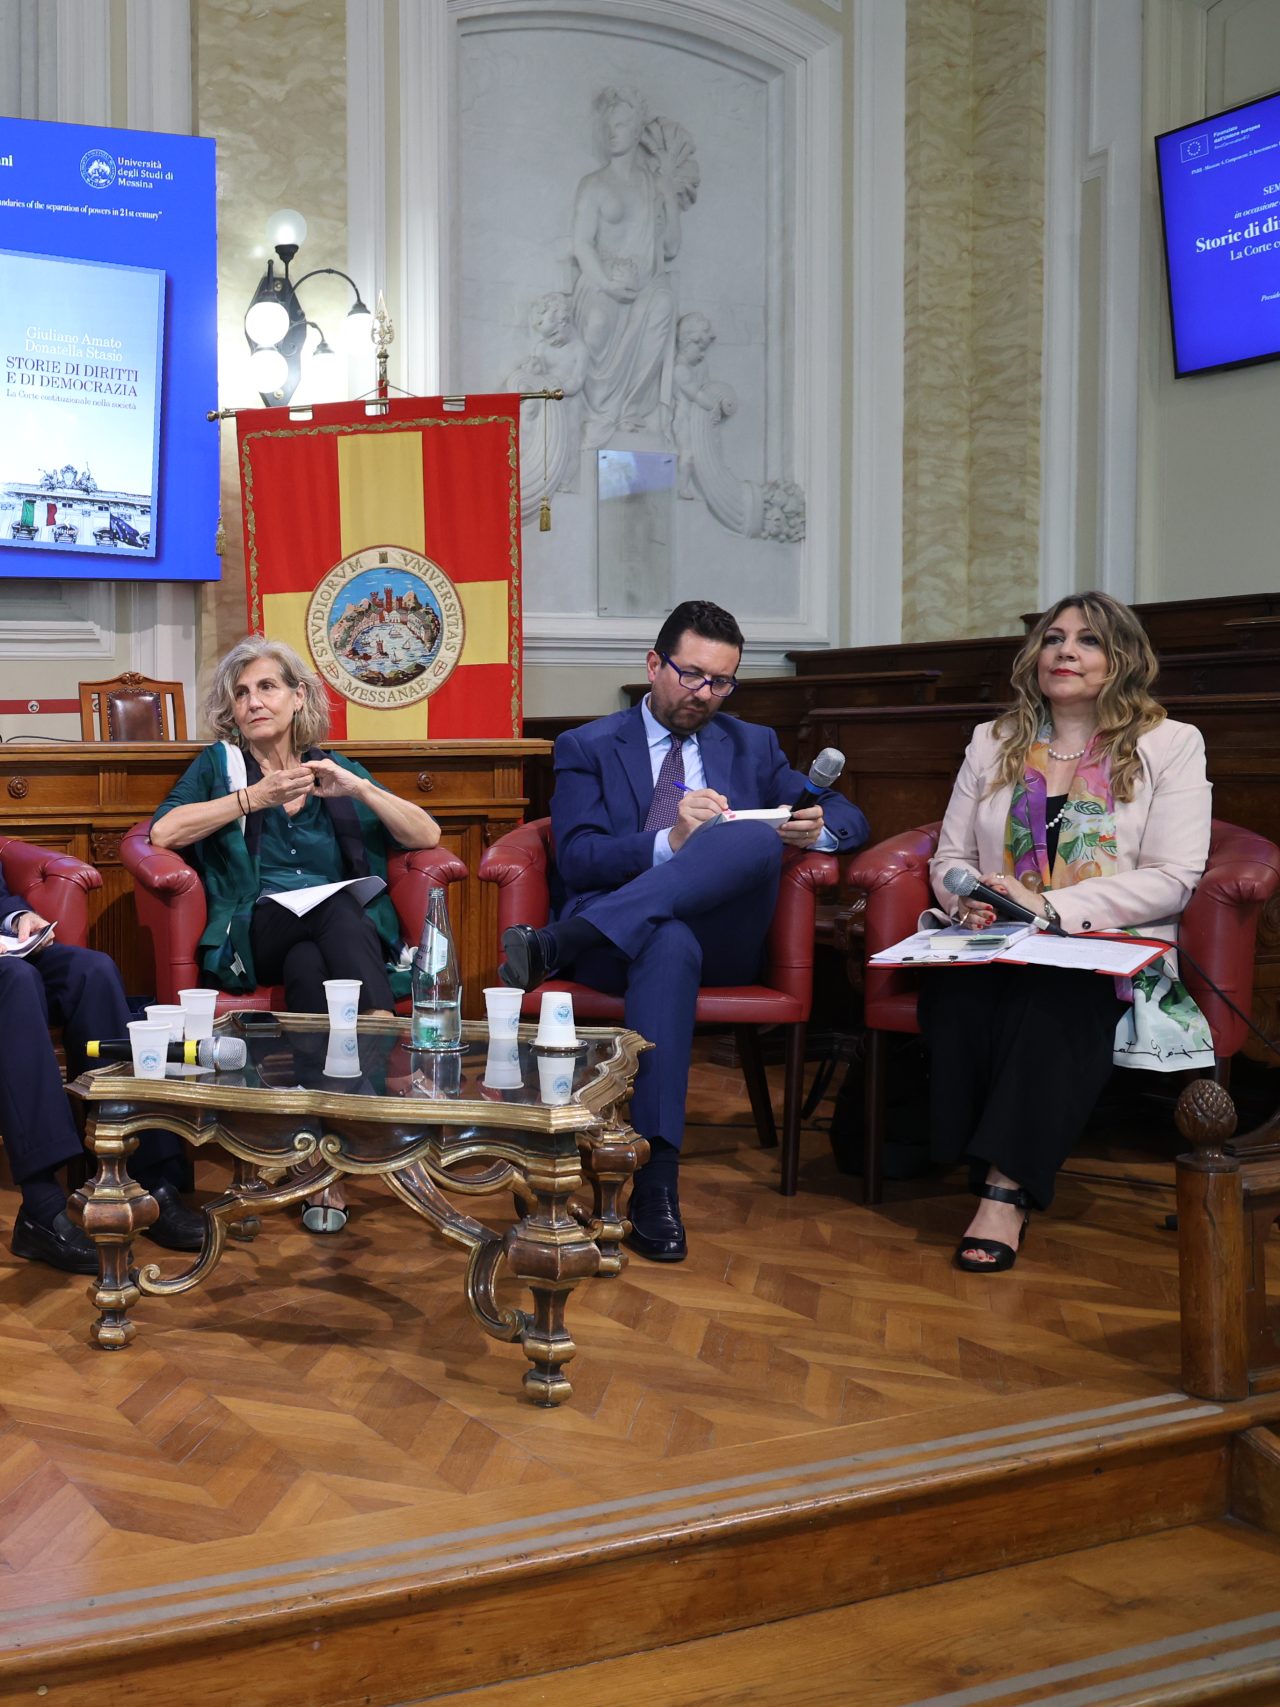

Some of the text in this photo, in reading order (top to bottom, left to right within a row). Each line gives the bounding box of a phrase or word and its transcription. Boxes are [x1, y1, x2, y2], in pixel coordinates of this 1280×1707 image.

[118, 157, 162, 170] Università
[118, 168, 173, 180] degli Studi di
[118, 178, 153, 189] Messina
[26, 200, 34, 209] of
[34, 200, 45, 209] the
[45, 203, 79, 212] separation
[80, 204, 89, 213] of
[88, 207, 112, 215] powers
[112, 207, 119, 216] in
[120, 207, 135, 217] 21st
[1195, 229, 1242, 253] Storie
[1244, 221, 1260, 239] di
[1230, 250, 1243, 261] La
[1244, 243, 1272, 257] Corte
[26, 327, 122, 348] Giuliano Amato
[25, 341, 123, 362] Donatella Stasio
[6, 356, 140, 382] STORIE DI DIRITTI
[6, 372, 137, 397] E DI DEMOCRAZIA
[6, 388, 137, 410] La Corte costituzionale nella società
[312, 558, 363, 658] STVDIORVM
[344, 677, 429, 703] MESSANAE
